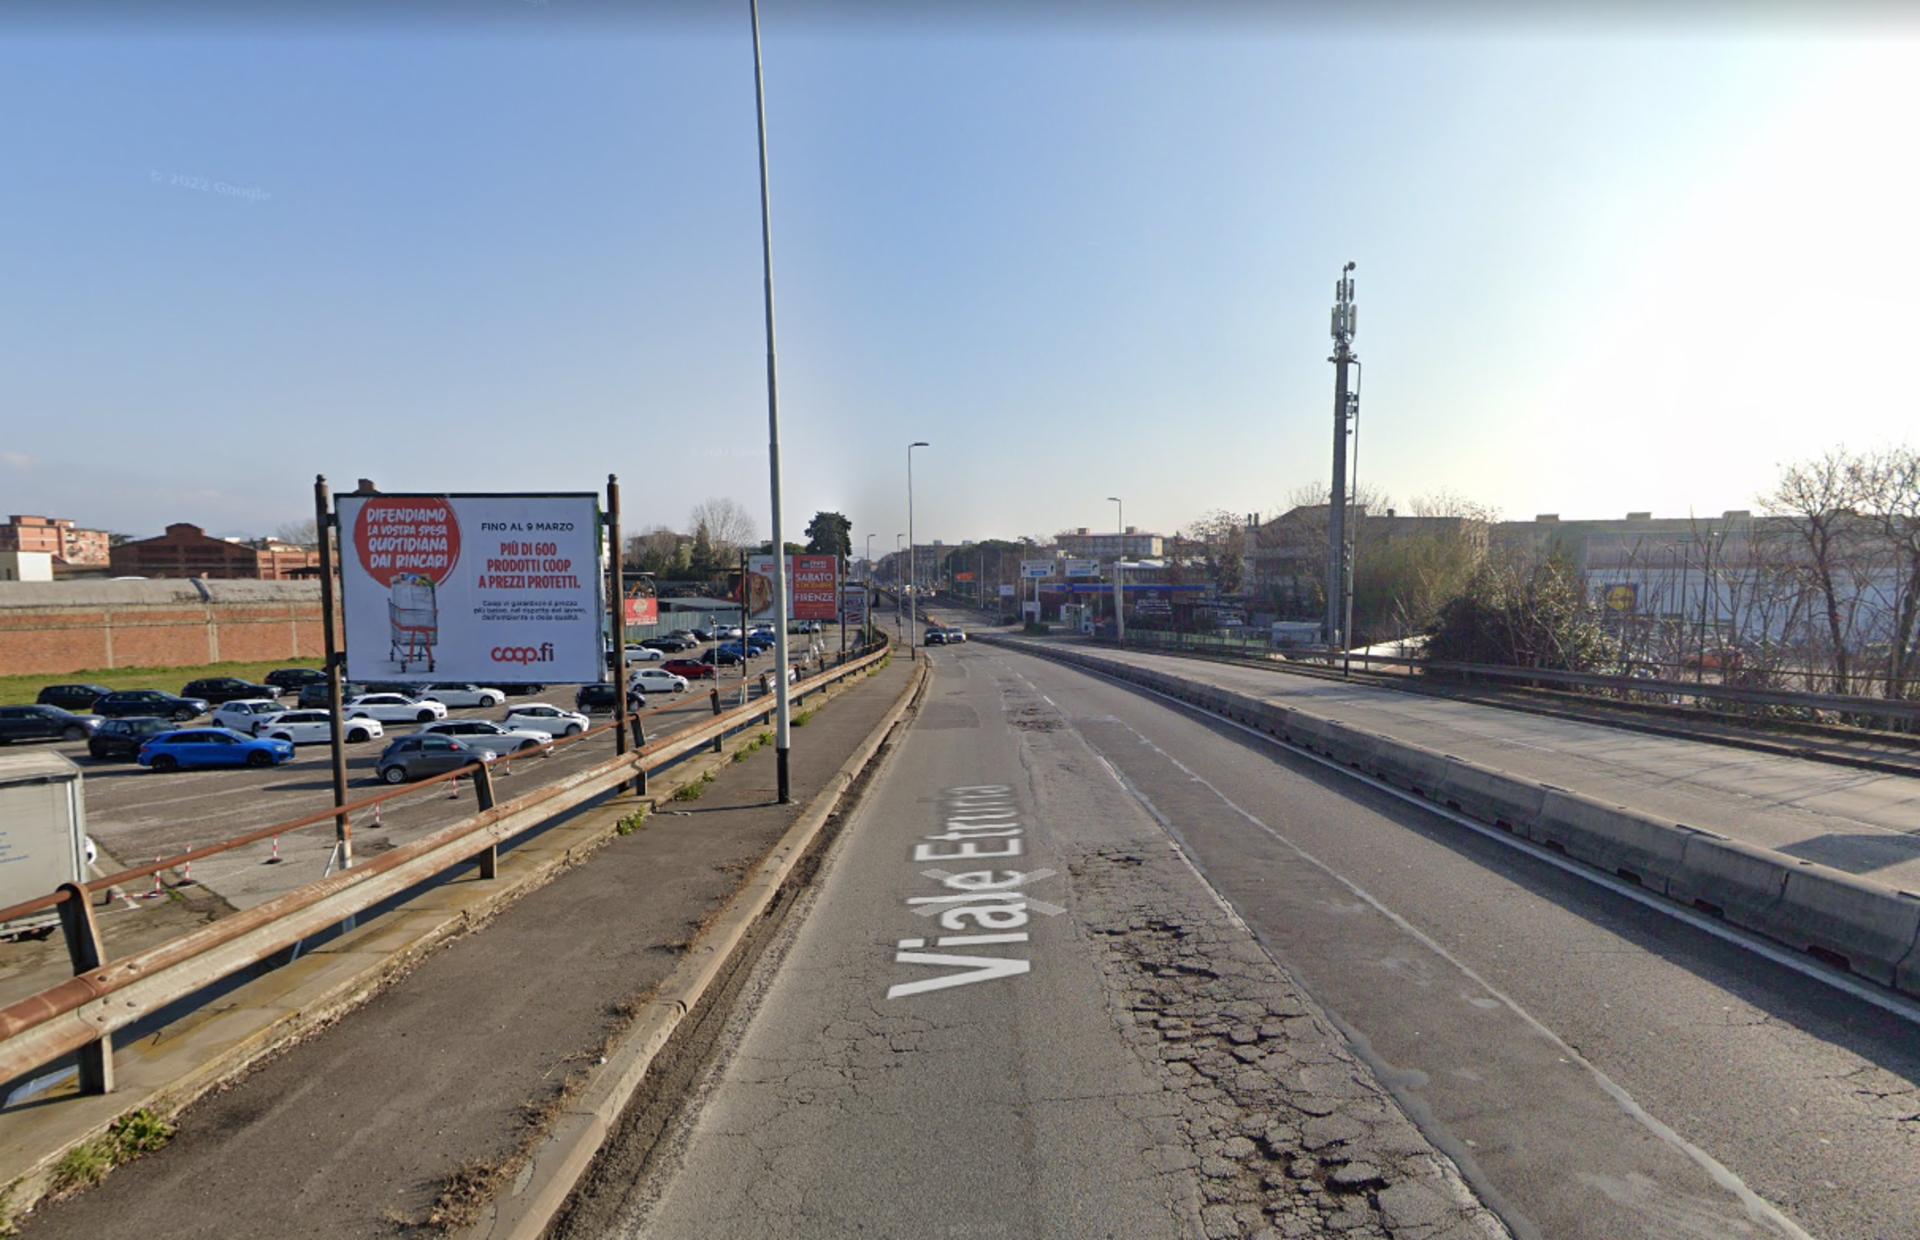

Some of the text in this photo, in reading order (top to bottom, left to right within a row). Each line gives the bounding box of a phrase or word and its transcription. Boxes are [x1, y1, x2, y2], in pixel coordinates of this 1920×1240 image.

[367, 507, 447, 523] DIFENDIAMO
[367, 524, 447, 537] LA VOSTRA SPESA
[481, 522, 575, 532] FINO AL 9 MARZO
[368, 537, 448, 553] QUOTIDIANA
[500, 540, 557, 556] PIÙ DI 600
[370, 553, 448, 569] DAI RINCARI
[487, 559, 571, 573] PRODOTTI COOP
[478, 575, 581, 589] A PREZZI PROTETTI.
[795, 572, 832, 583] SABATO
[795, 592, 834, 602] FIRENZE
[490, 642, 554, 666] coop.fi
